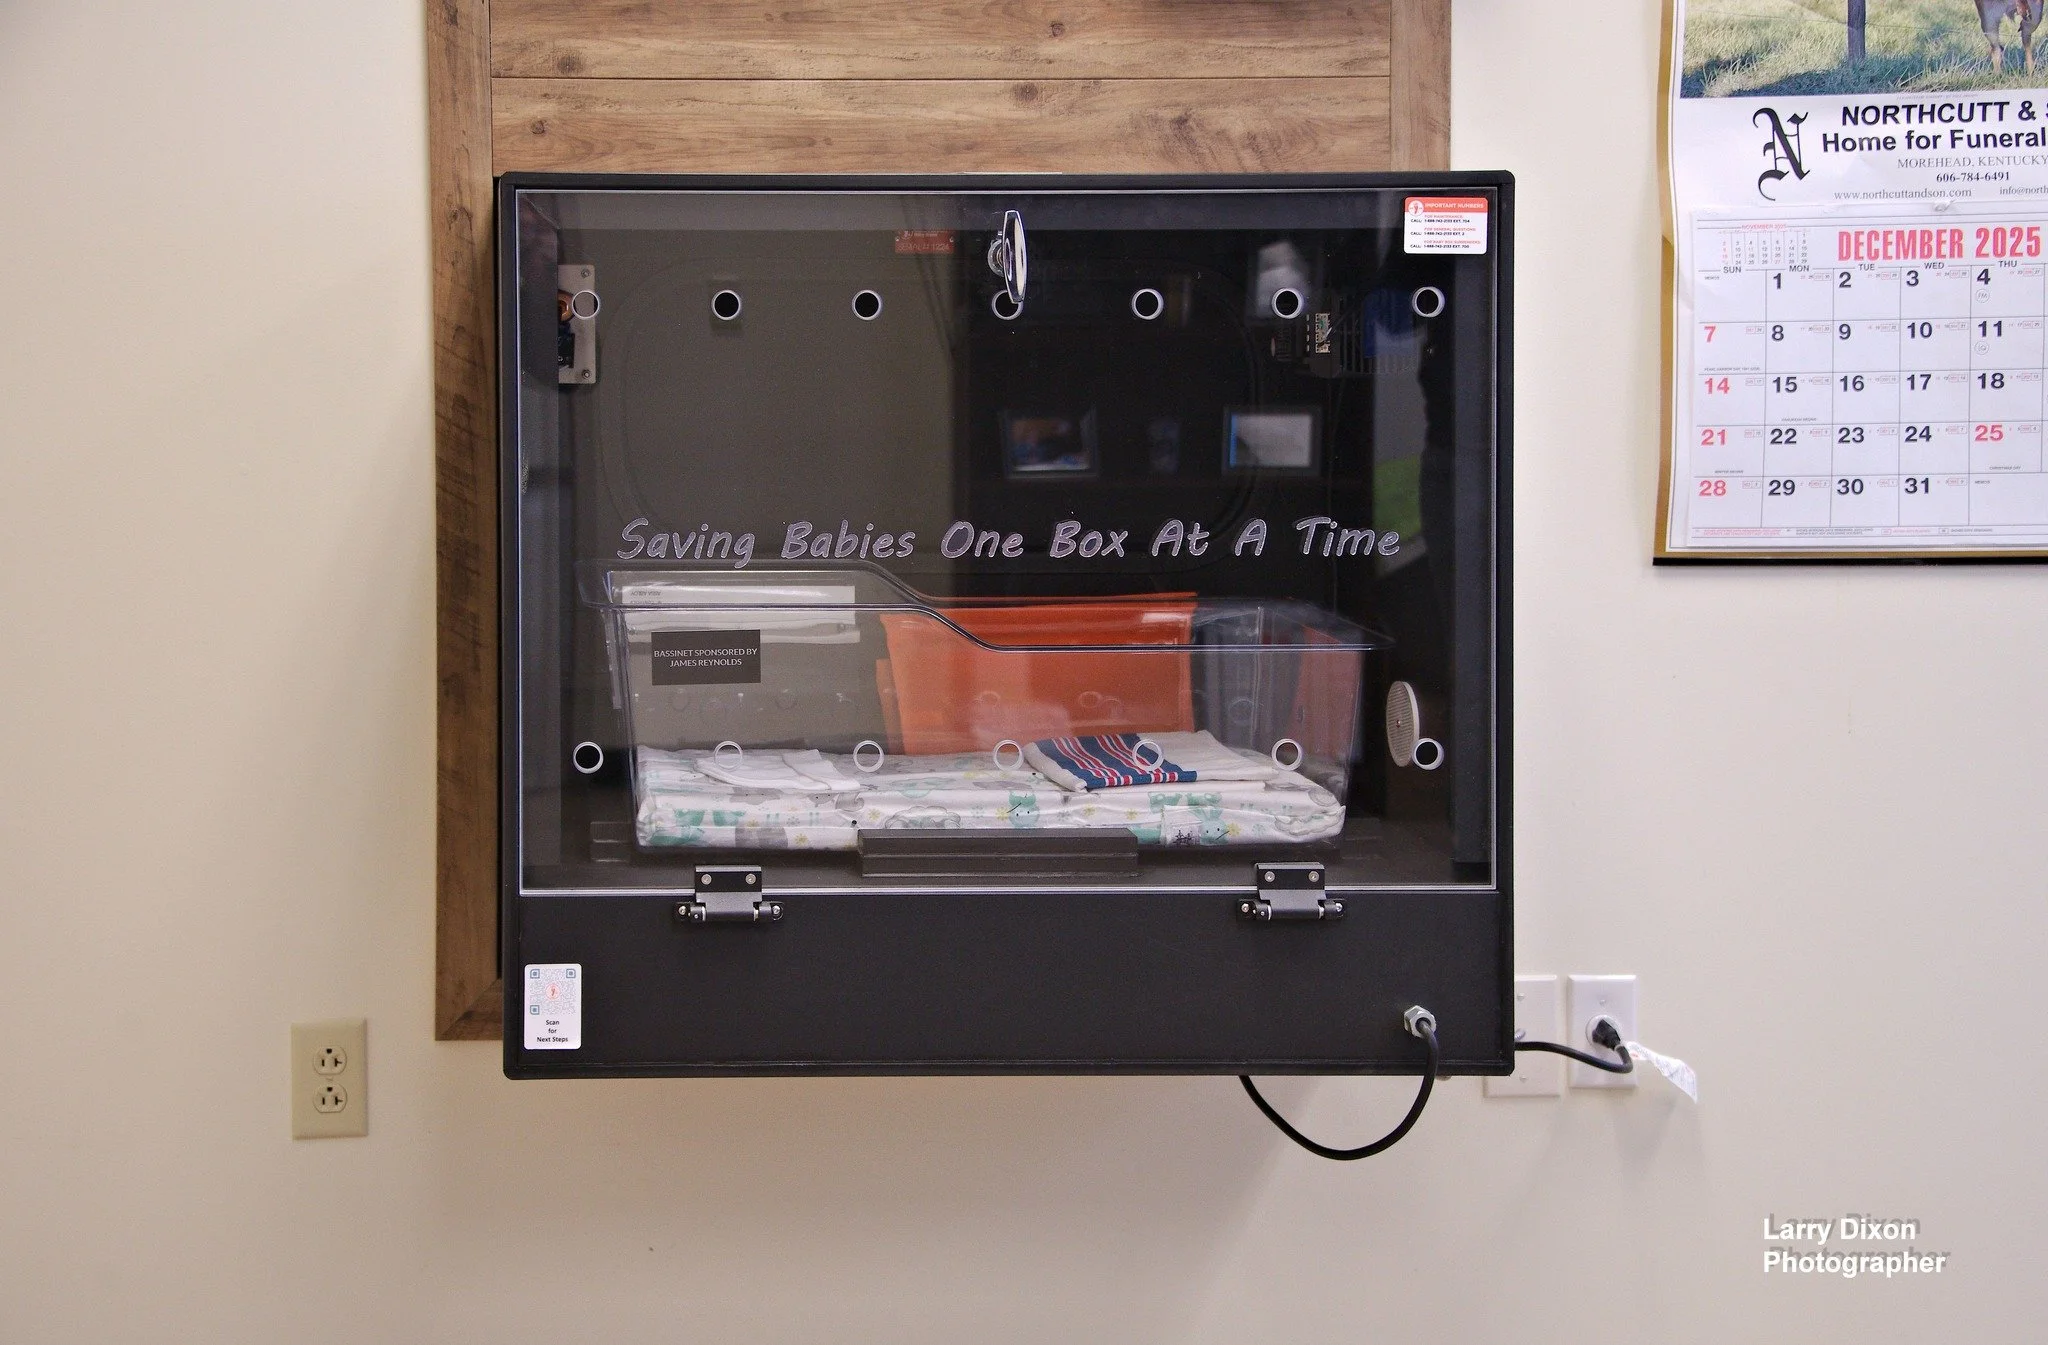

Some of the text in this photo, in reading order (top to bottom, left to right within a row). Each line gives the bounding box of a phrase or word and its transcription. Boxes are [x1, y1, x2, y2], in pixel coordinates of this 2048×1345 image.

[1841, 101, 2010, 126] NORTHCUTT
[2017, 100, 2037, 121] &
[1822, 127, 2046, 152] Home for Funeral
[1897, 155, 2048, 169] MOREHEAD, KENTUCKY
[1936, 171, 2010, 182] 606-784-6491
[1834, 188, 1972, 200] www.northcuttandson.com
[2000, 185, 2048, 195] info@north
[1838, 226, 2041, 262] DECEMBER 2025
[1773, 272, 1782, 289] 1
[1839, 272, 1852, 288] 2
[1906, 270, 1919, 287] 3
[1977, 268, 1991, 285] 4
[1704, 326, 1716, 342] 7
[1772, 325, 1784, 341] 8
[1839, 324, 1851, 340] 9
[1907, 322, 1932, 339] 10
[1978, 320, 2002, 337] 11
[1704, 377, 1730, 394] 14
[1772, 376, 1798, 393] 15
[1840, 375, 1865, 392] 16
[1907, 374, 1932, 391] 17
[1977, 372, 2005, 389] 18
[1701, 429, 1727, 446] 21
[1770, 428, 1797, 444] 22
[1838, 427, 1865, 444] 23
[1905, 426, 1932, 442] 24
[1975, 425, 2004, 442] 25
[1699, 480, 1726, 496] 28
[1768, 479, 1796, 496] 29
[1837, 478, 1864, 495] 30
[1905, 477, 1929, 494] 31
[616, 516, 1401, 569] Saving Babies One Box At A Time
[654, 650, 693, 658] BASSINET
[695, 649, 745, 657] SPONSORED
[698, 658, 742, 667] REYNOLDS
